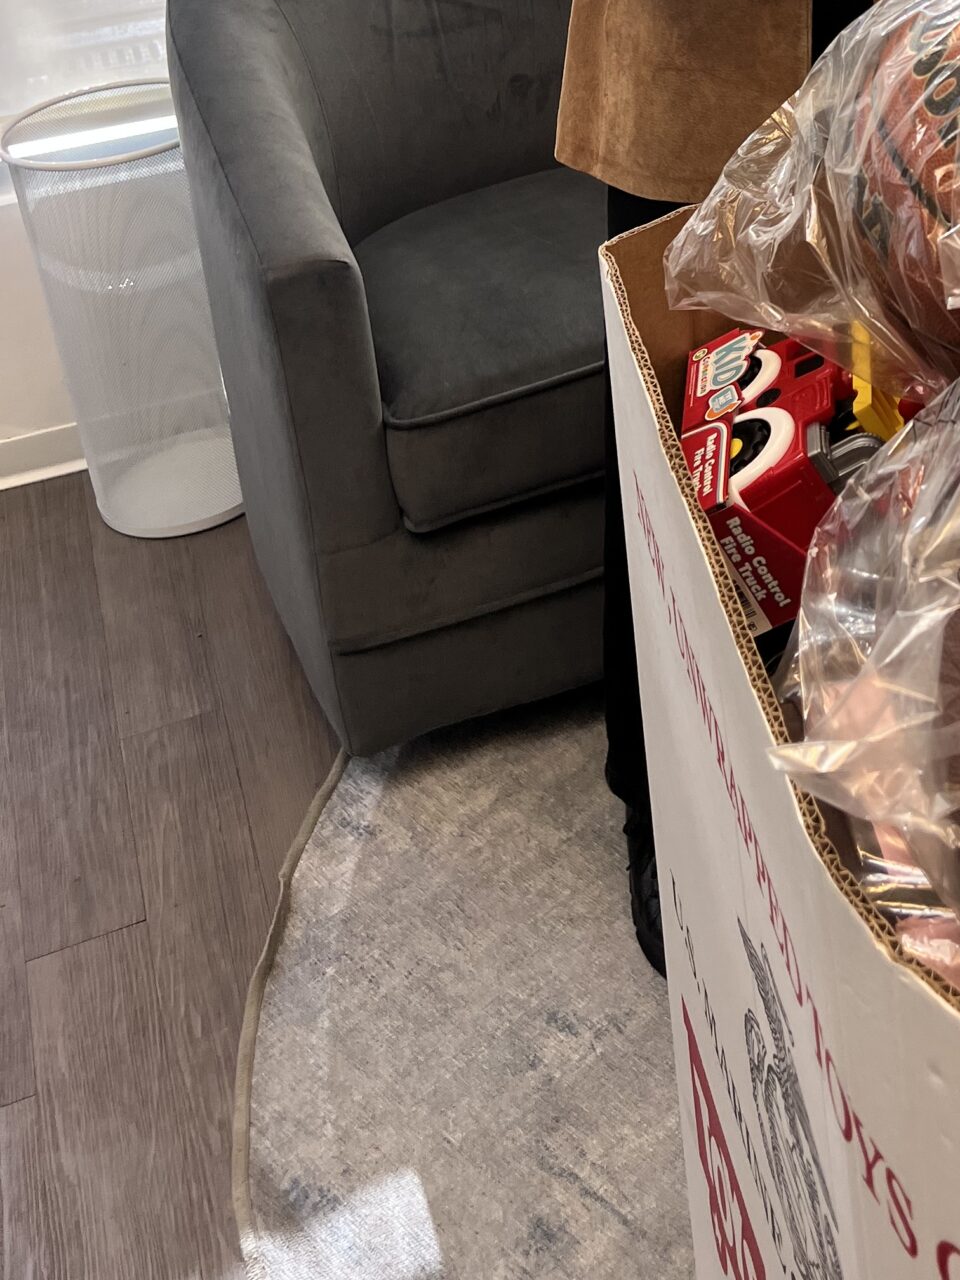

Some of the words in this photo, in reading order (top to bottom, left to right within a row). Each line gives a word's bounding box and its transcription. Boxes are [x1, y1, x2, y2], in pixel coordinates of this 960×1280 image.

[711, 335, 748, 387] KID
[694, 447, 704, 468] Fire
[702, 458, 716, 497] Control
[720, 535, 742, 564] Fire
[738, 561, 767, 602] Truck
[726, 516, 756, 556] Radio
[751, 555, 792, 608] Control
[669, 584, 803, 1008] UNWRAPPED
[805, 984, 918, 1260] TOYS
[702, 977, 787, 1275] MARINE
